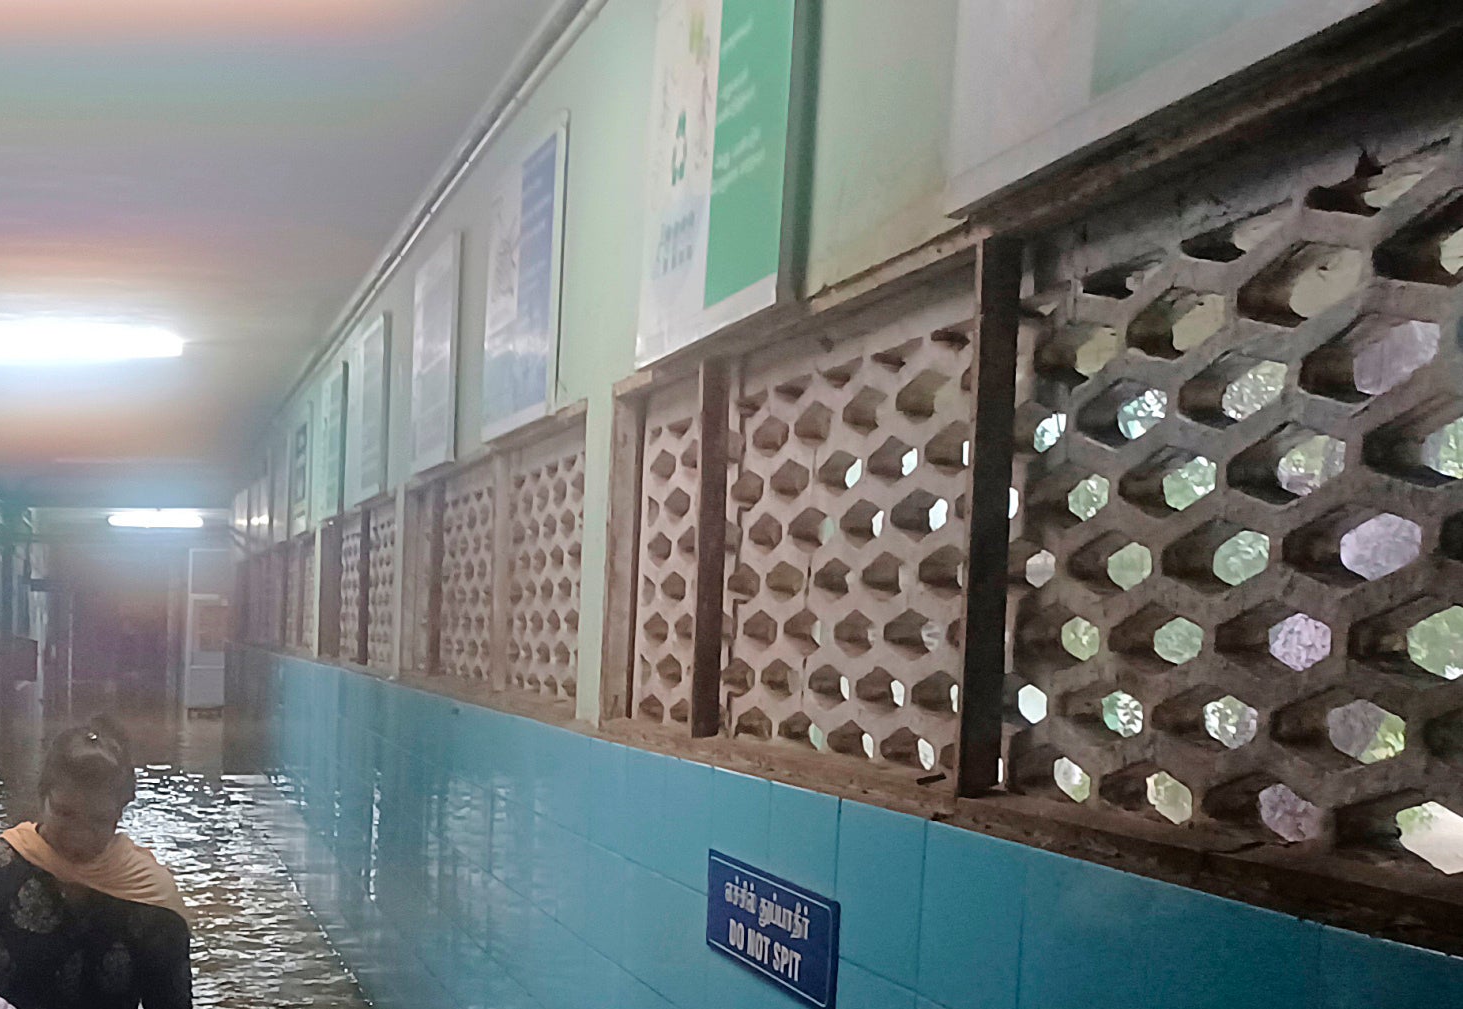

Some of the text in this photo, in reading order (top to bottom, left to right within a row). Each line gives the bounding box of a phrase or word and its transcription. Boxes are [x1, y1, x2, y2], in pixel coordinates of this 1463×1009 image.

[729, 918, 802, 982] DO NOT SPIT
